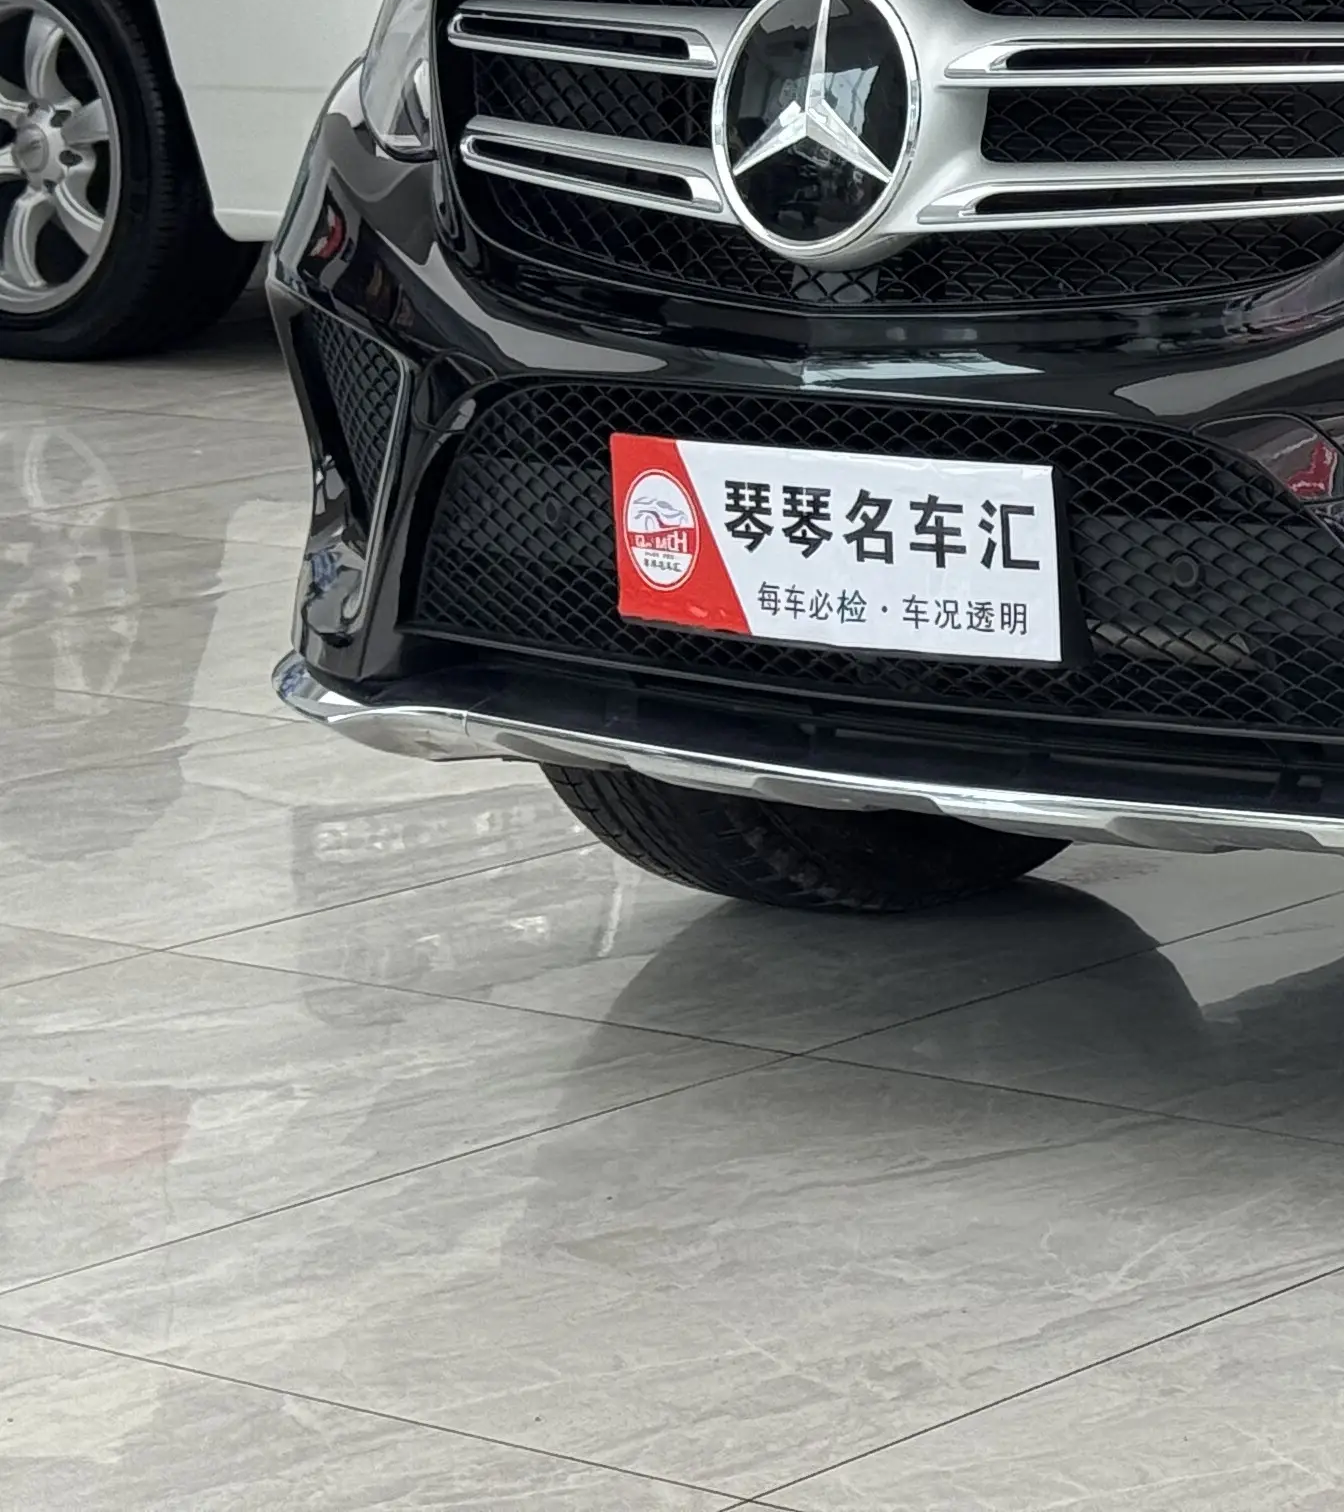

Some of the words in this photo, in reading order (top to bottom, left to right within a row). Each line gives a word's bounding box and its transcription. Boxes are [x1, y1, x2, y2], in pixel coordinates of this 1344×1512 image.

[723, 480, 1041, 571] 琴琴名车汇
